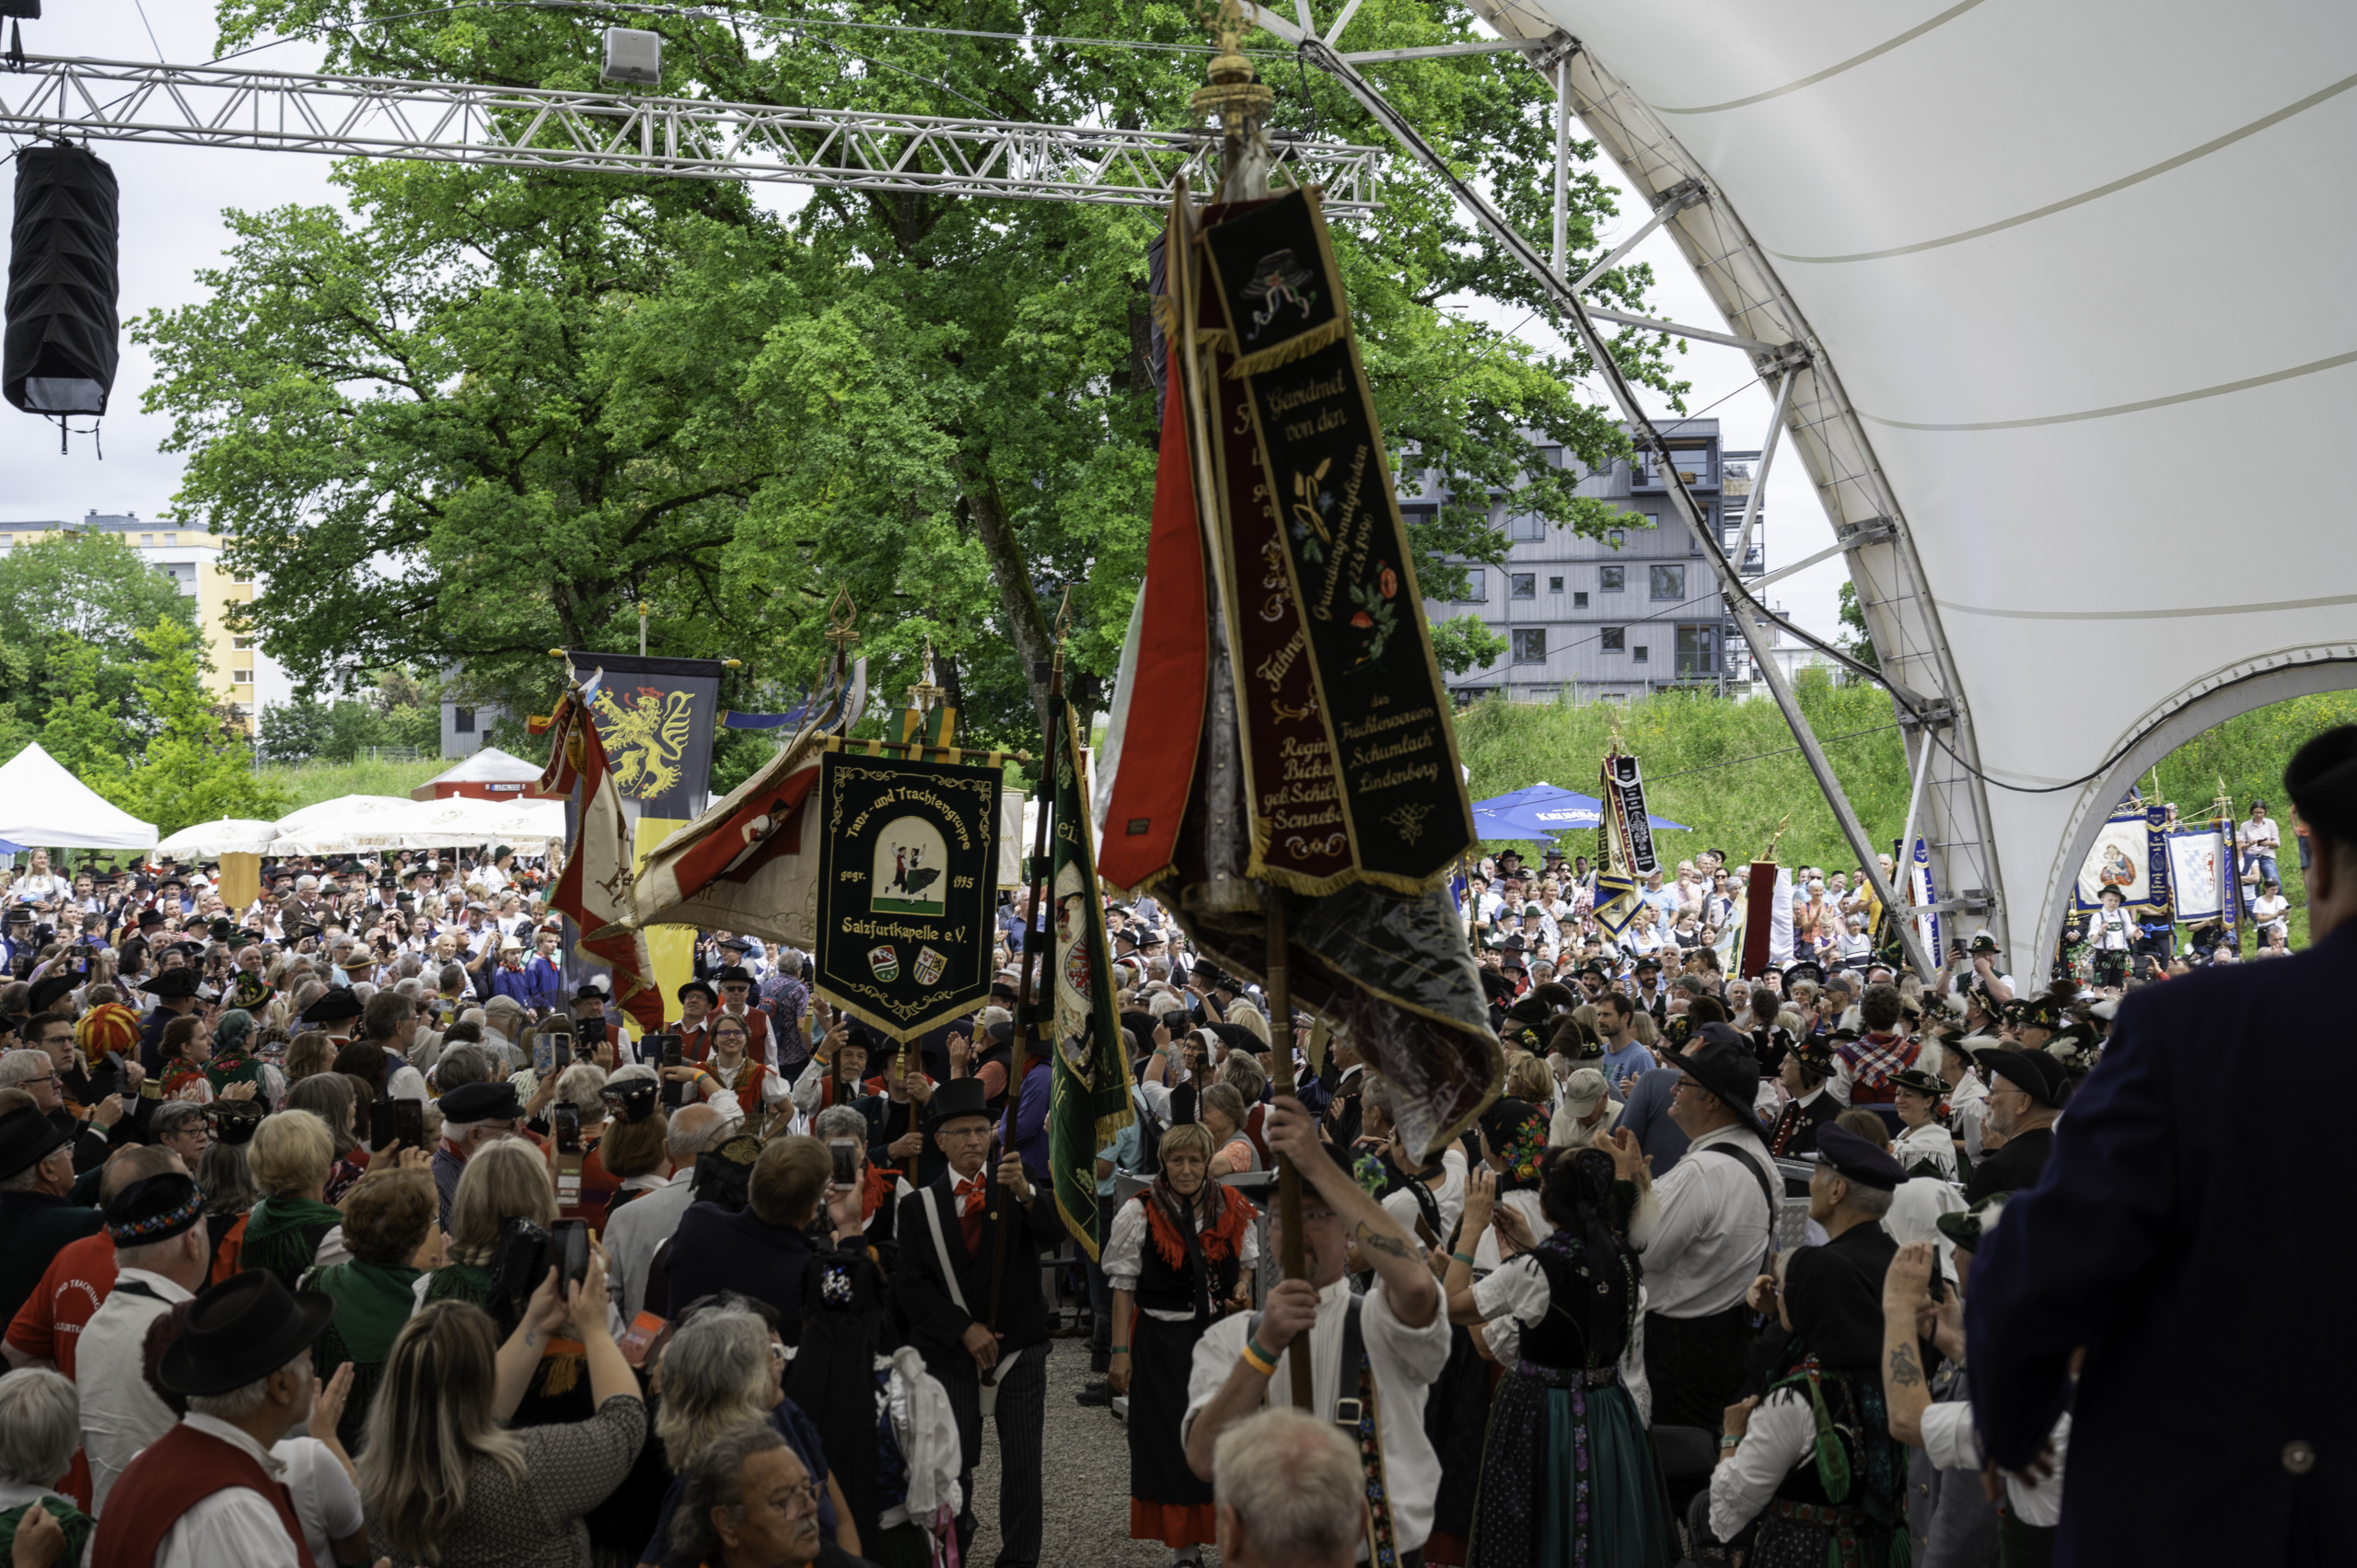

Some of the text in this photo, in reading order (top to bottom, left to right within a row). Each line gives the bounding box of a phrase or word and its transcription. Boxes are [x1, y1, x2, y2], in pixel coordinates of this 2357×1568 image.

[1265, 367, 1348, 422] Gewidmet
[1283, 406, 1349, 442] von den
[1312, 444, 1368, 621] Gründungsmitgliedern
[1255, 629, 1306, 692] Fahne
[1370, 691, 1390, 708] des
[1339, 703, 1435, 743] Trachtenvereins
[1283, 758, 1336, 781] Bicke
[1358, 761, 1439, 795] Lindenberg
[1264, 785, 1290, 813] geb.
[874, 788, 896, 808] und
[895, 786, 971, 850] Trachtengruppe
[841, 870, 974, 889] gegr. 1995
[842, 916, 939, 944] Salzfurtkapelle
